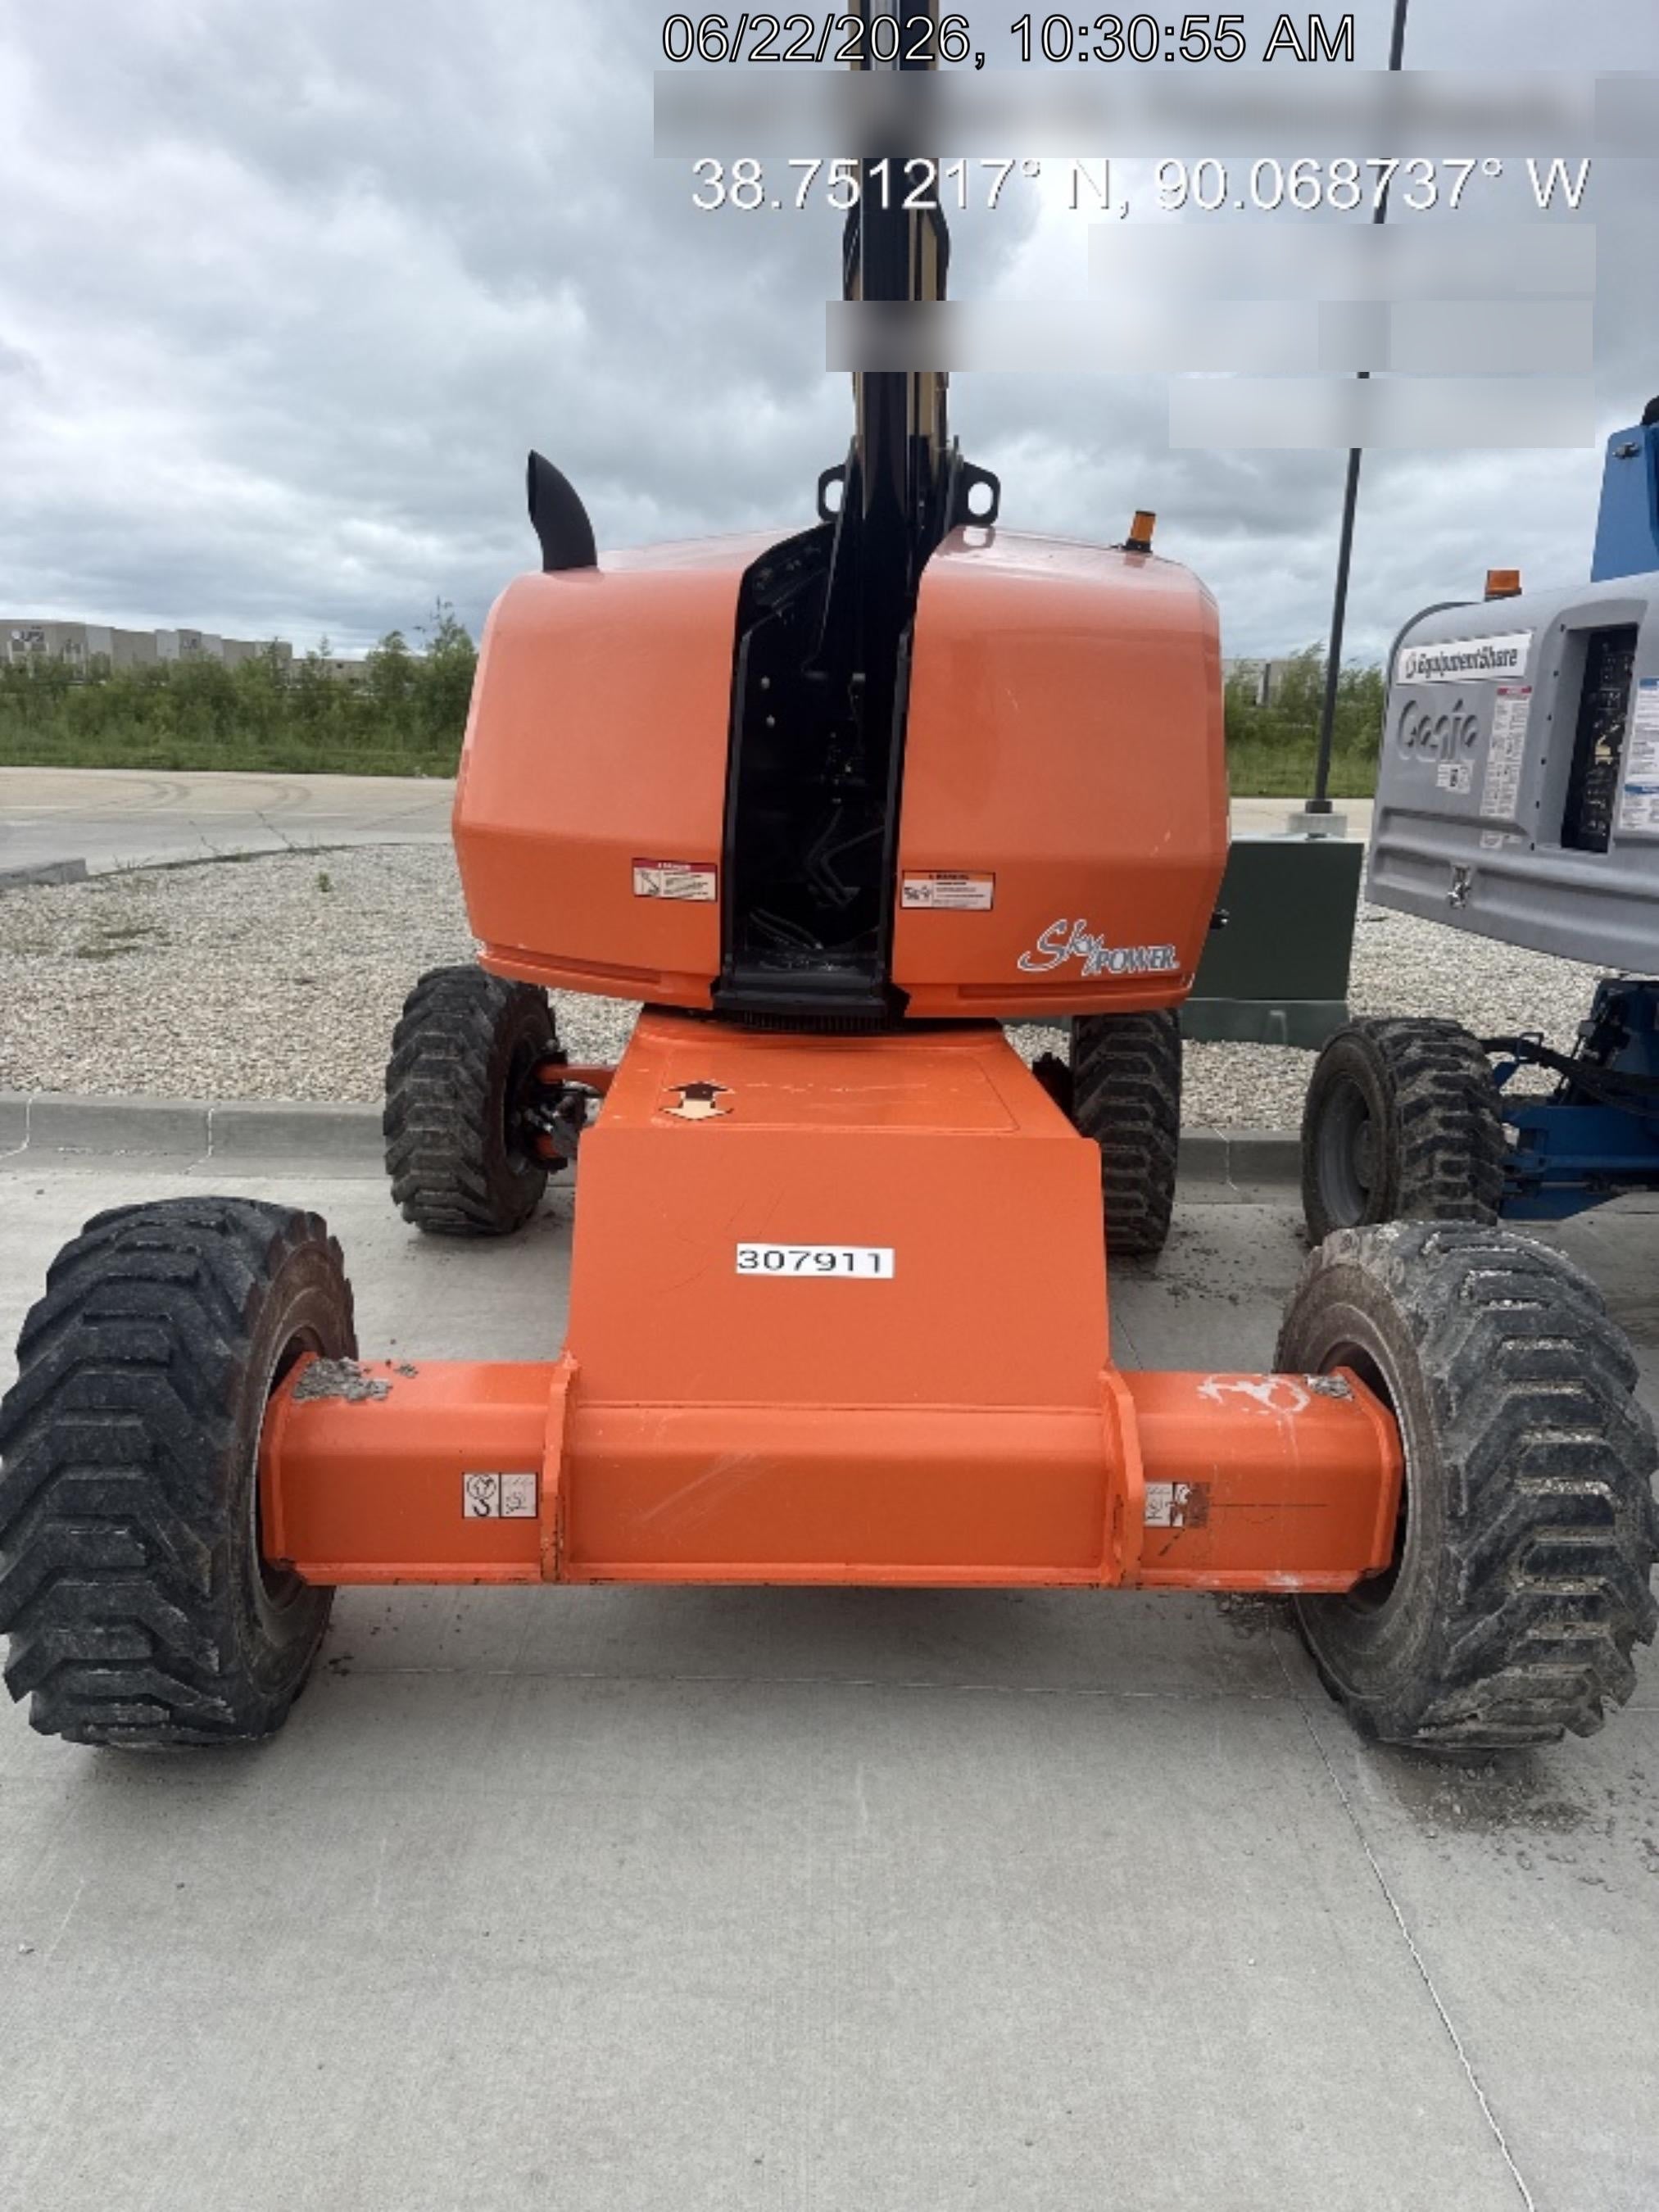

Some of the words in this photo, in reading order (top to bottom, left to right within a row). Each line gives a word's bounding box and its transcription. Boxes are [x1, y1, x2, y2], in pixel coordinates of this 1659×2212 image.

[1397, 697, 1480, 762] Genie
[1017, 918, 1105, 977] Sky
[1094, 943, 1177, 975] POWER
[738, 1249, 881, 1273] 307911
